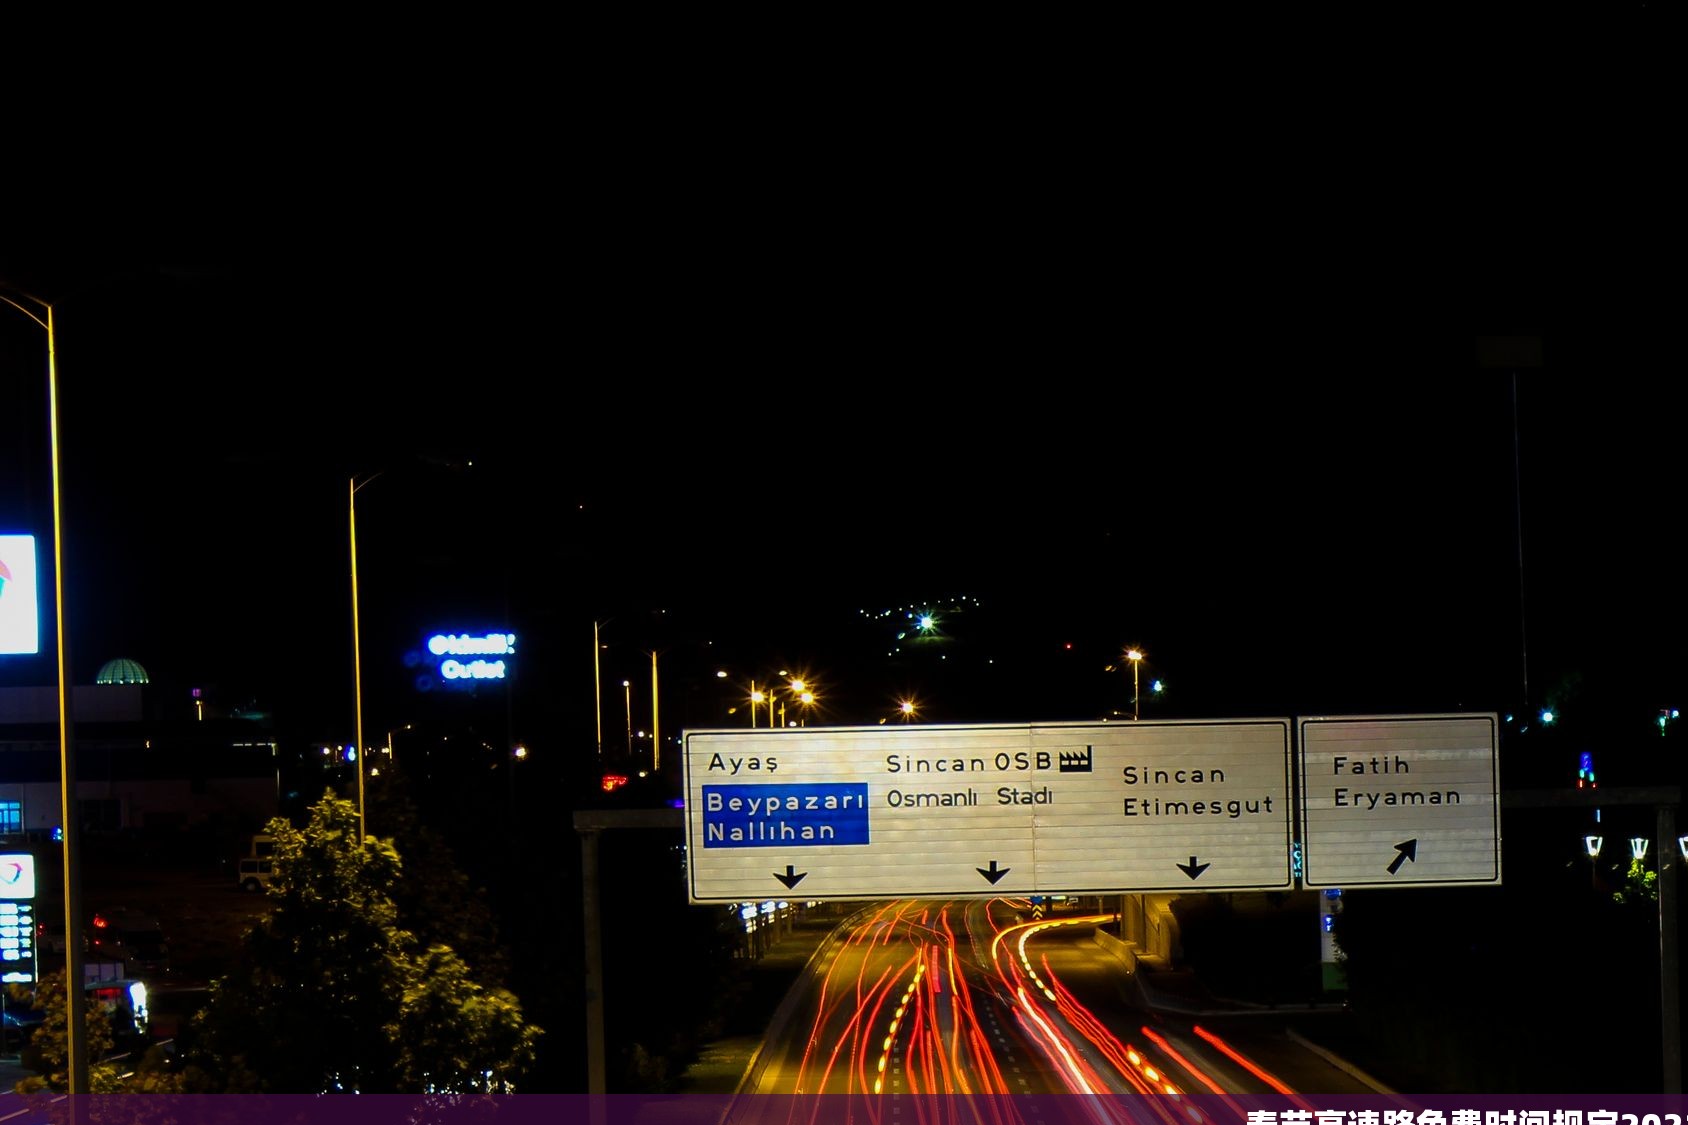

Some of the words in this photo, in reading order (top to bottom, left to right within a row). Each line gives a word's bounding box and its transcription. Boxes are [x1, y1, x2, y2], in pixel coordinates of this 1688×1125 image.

[708, 752, 778, 775] Ayaş
[886, 754, 985, 773] Sincan
[994, 751, 1052, 771] OSB
[1333, 755, 1410, 775] Fatih
[1123, 766, 1226, 785] Sincan
[707, 792, 863, 817] Beypazarı
[887, 787, 977, 807] Osmanlı
[997, 786, 1053, 805] Stadı
[1123, 796, 1273, 819] Etimesgut
[1334, 787, 1461, 810] Eryaman
[708, 821, 835, 841] Nallıhan
